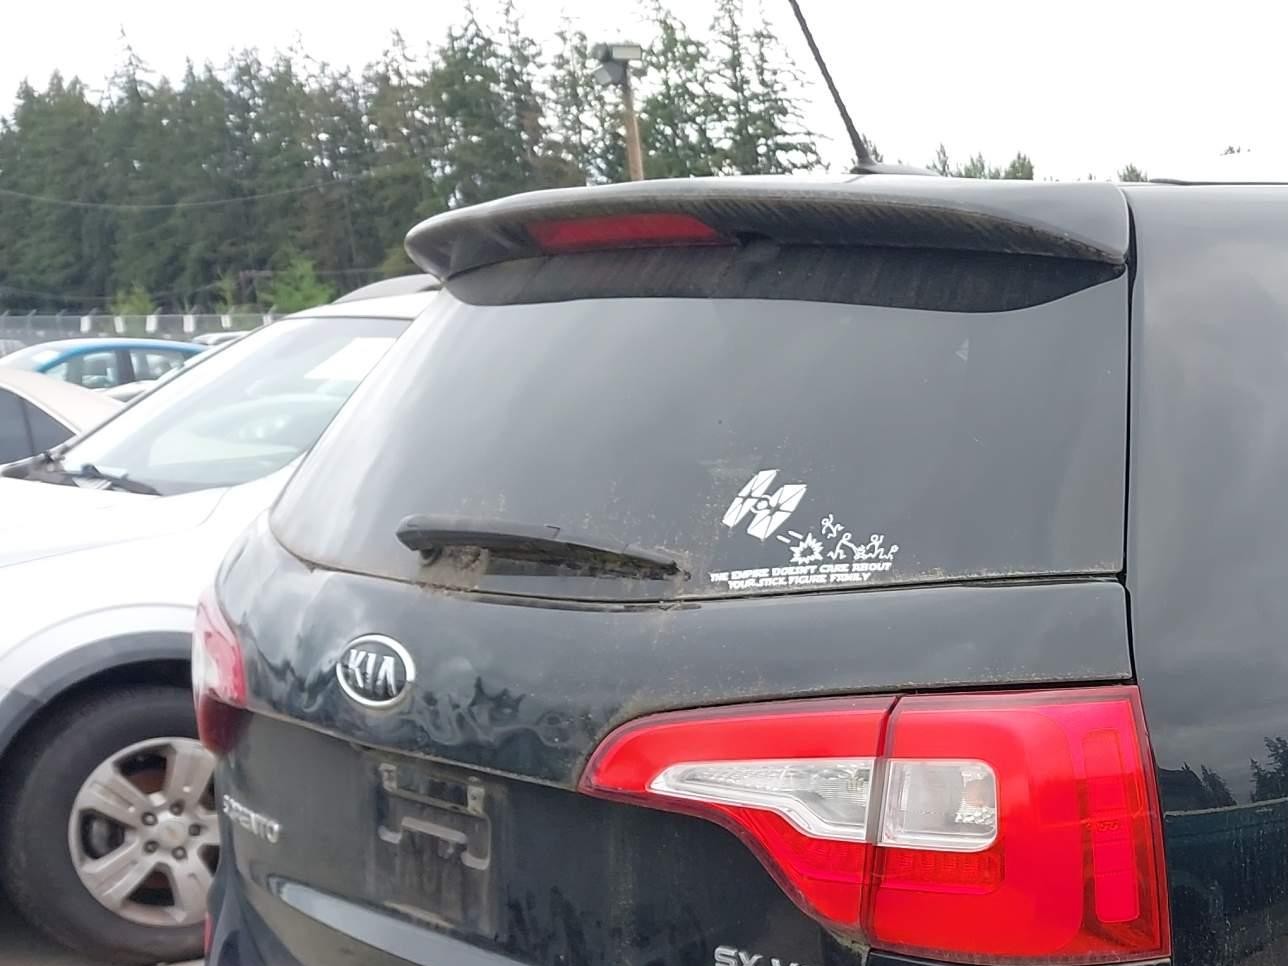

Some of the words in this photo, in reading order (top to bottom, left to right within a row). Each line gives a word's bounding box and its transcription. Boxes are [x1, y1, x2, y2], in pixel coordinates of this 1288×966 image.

[710, 571, 729, 582] THE
[851, 561, 893, 572] ABOUT
[788, 574, 827, 585] FIGURE
[829, 571, 872, 582] FAMILY
[348, 648, 398, 697] KIA
